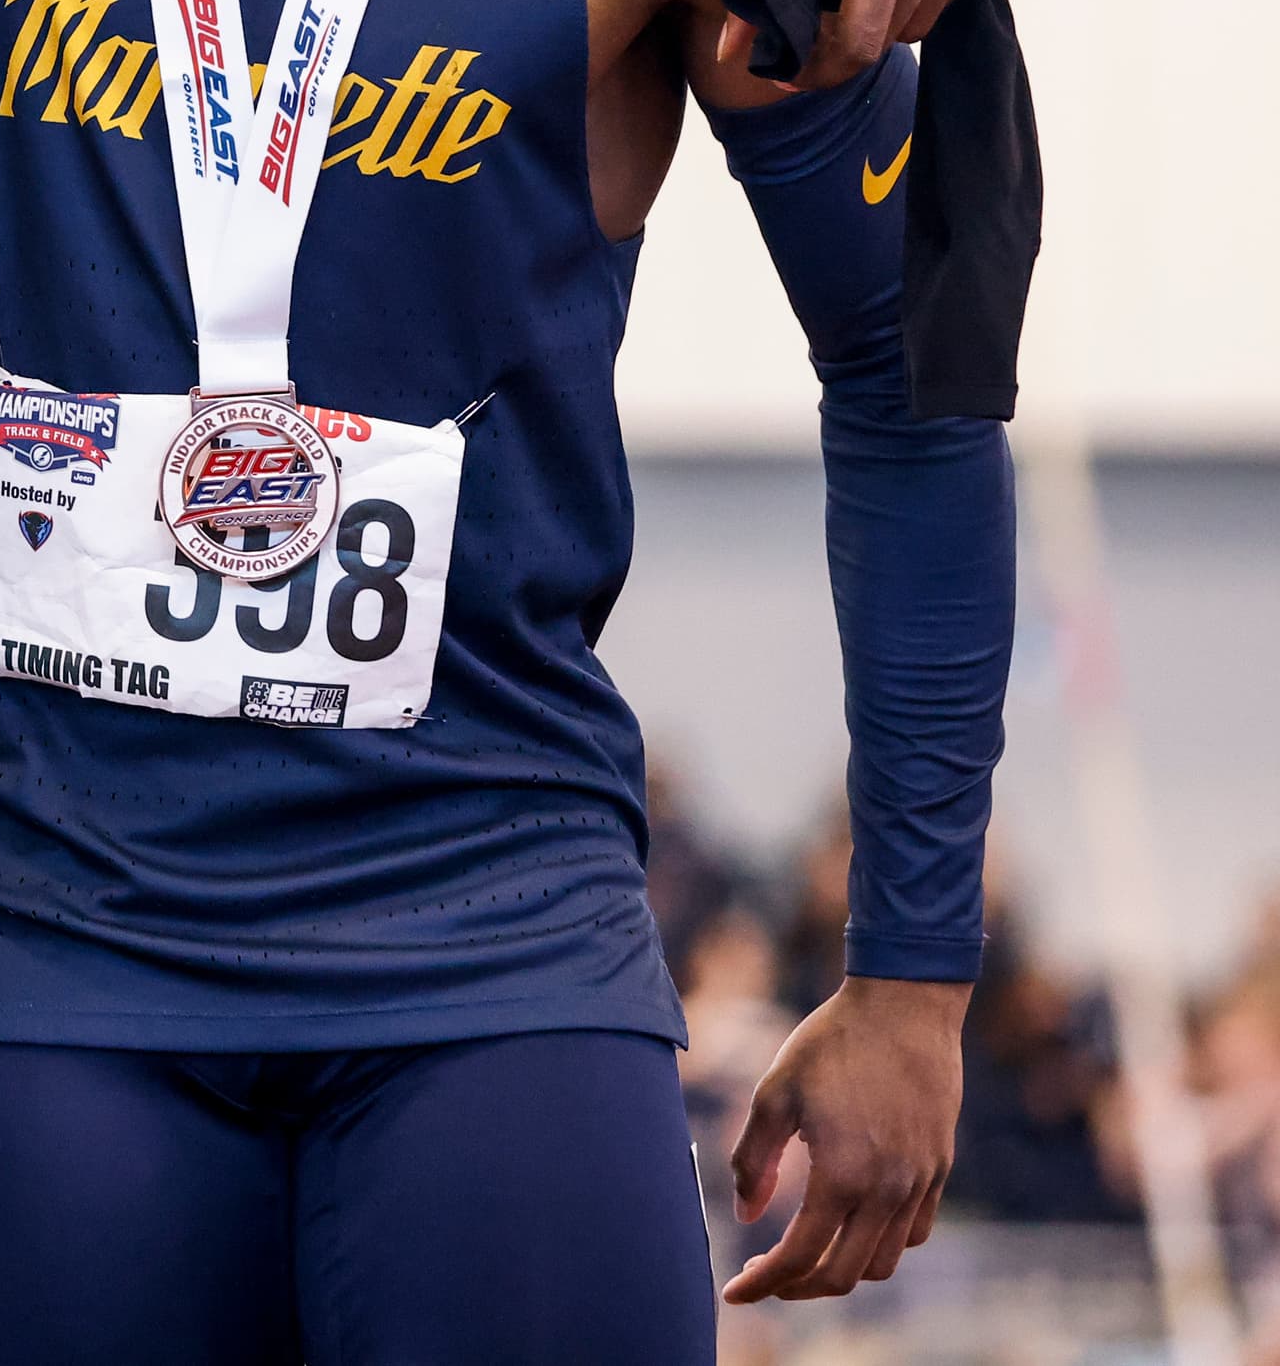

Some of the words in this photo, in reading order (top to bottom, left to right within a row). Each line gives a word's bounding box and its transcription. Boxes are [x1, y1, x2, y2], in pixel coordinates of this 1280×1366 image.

[308, 16, 341, 117] CONFERENCE
[182, 73, 203, 178] CONFERENCE
[4, 426, 38, 438] TRACK
[42, 429, 51, 440] &
[53, 431, 85, 448] FIELD
[169, 417, 217, 474] INDOOR
[217, 406, 271, 424] TRACK
[275, 413, 288, 427] &
[290, 422, 325, 462] FIELD
[73, 472, 93, 483] Jeep
[201, 447, 296, 477] BIG
[0, 481, 53, 504] Hosted
[57, 490, 76, 511] by
[186, 473, 327, 508] EAST
[215, 510, 313, 526] CONFERENCE
[188, 527, 319, 572] CHAMPIONSHIPS
[1, 639, 102, 690] TIMING
[110, 658, 170, 700] TAG
[243, 703, 341, 723] CHANGE
